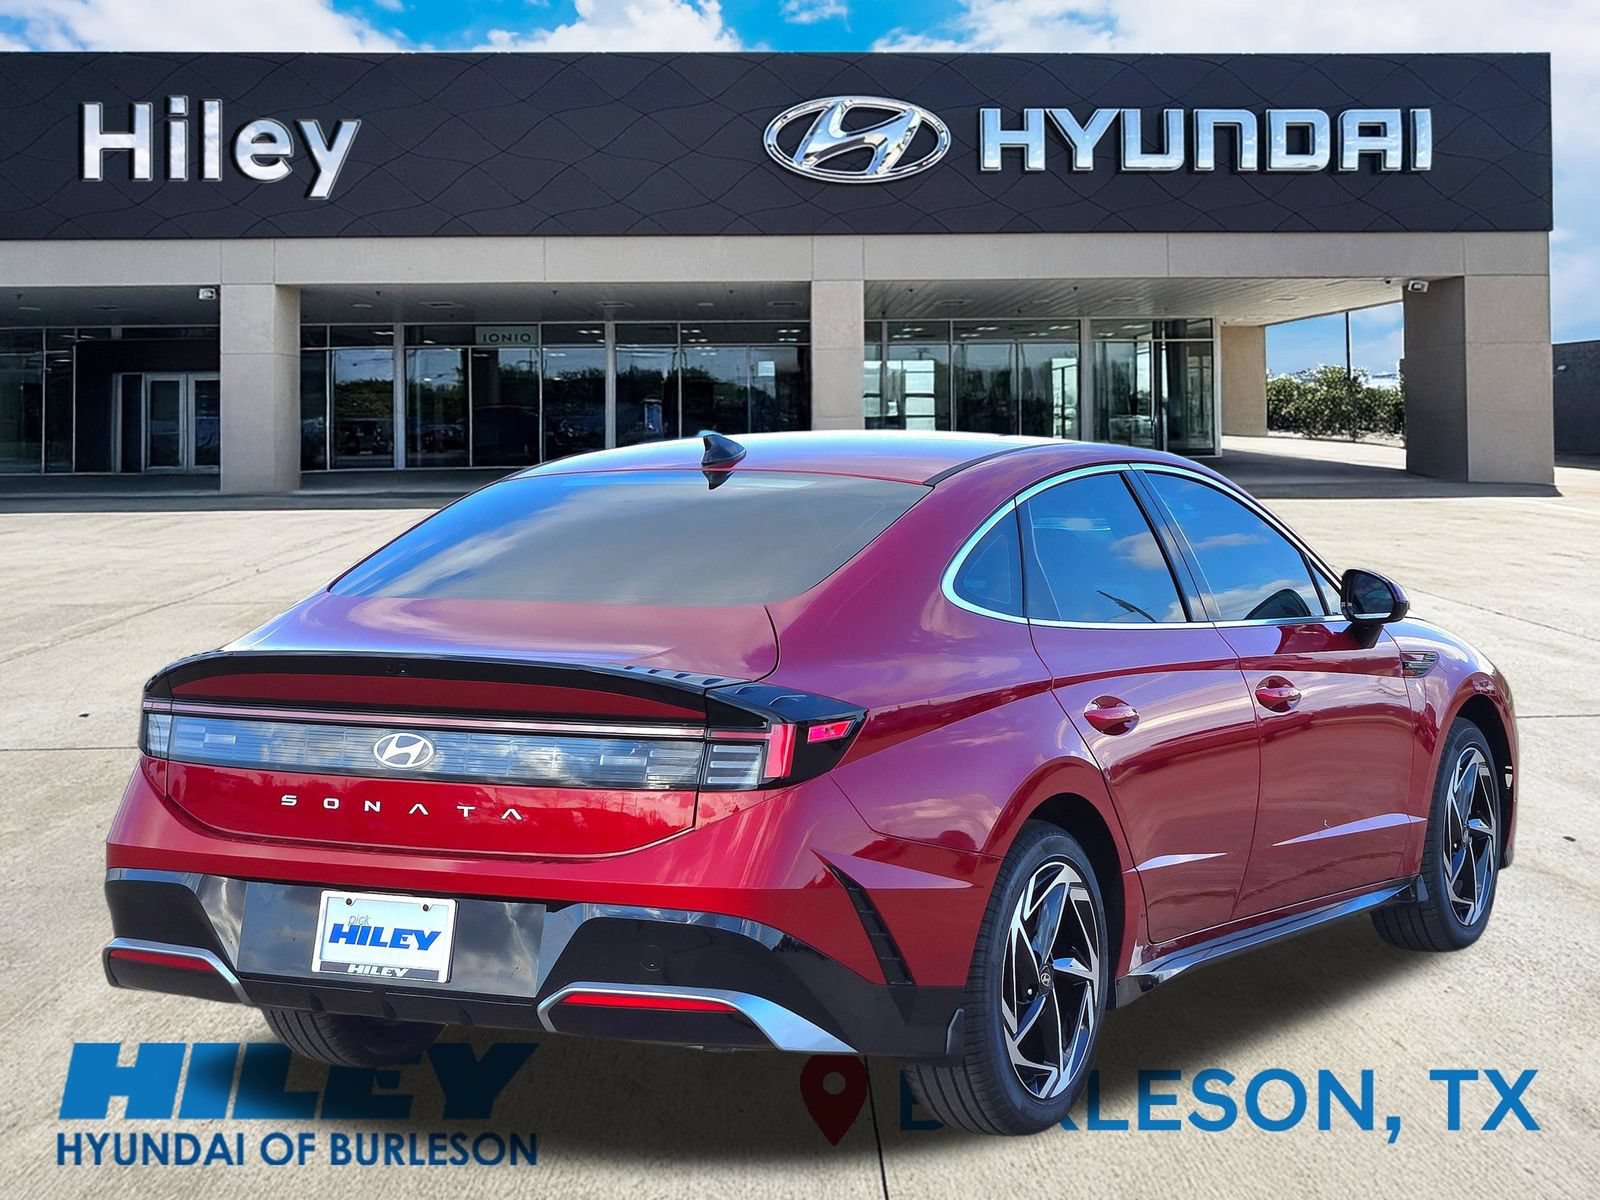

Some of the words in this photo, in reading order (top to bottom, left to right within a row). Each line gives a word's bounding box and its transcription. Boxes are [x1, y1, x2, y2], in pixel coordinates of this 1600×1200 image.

[79, 95, 361, 199] Hiley
[979, 107, 1432, 173] HYUNDAI
[280, 794, 523, 821] SONATA
[347, 914, 371, 927] pick
[328, 923, 442, 951] HILEY
[347, 963, 410, 978] HILEY
